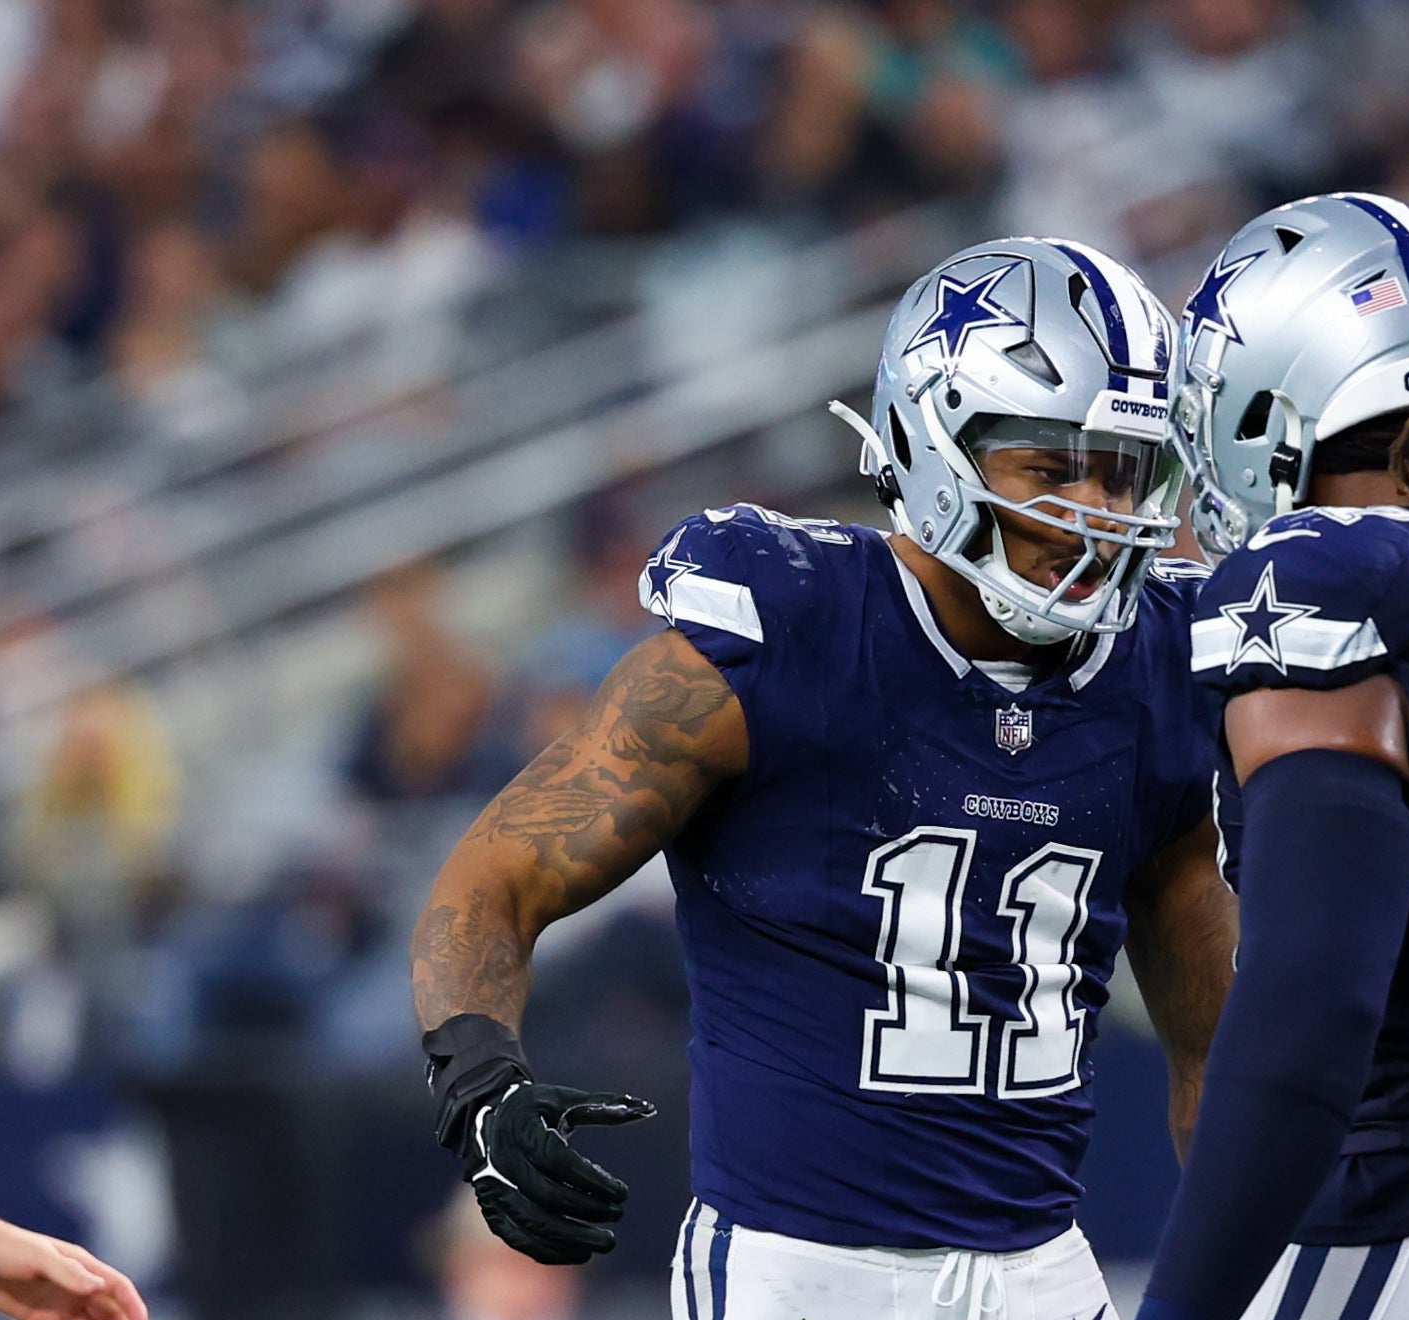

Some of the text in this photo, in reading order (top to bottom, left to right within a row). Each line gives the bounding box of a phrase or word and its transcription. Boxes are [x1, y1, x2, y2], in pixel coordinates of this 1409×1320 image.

[1001, 726, 1028, 746] NFL
[964, 794, 1060, 827] COWBOYS
[859, 826, 1104, 1099] 11
